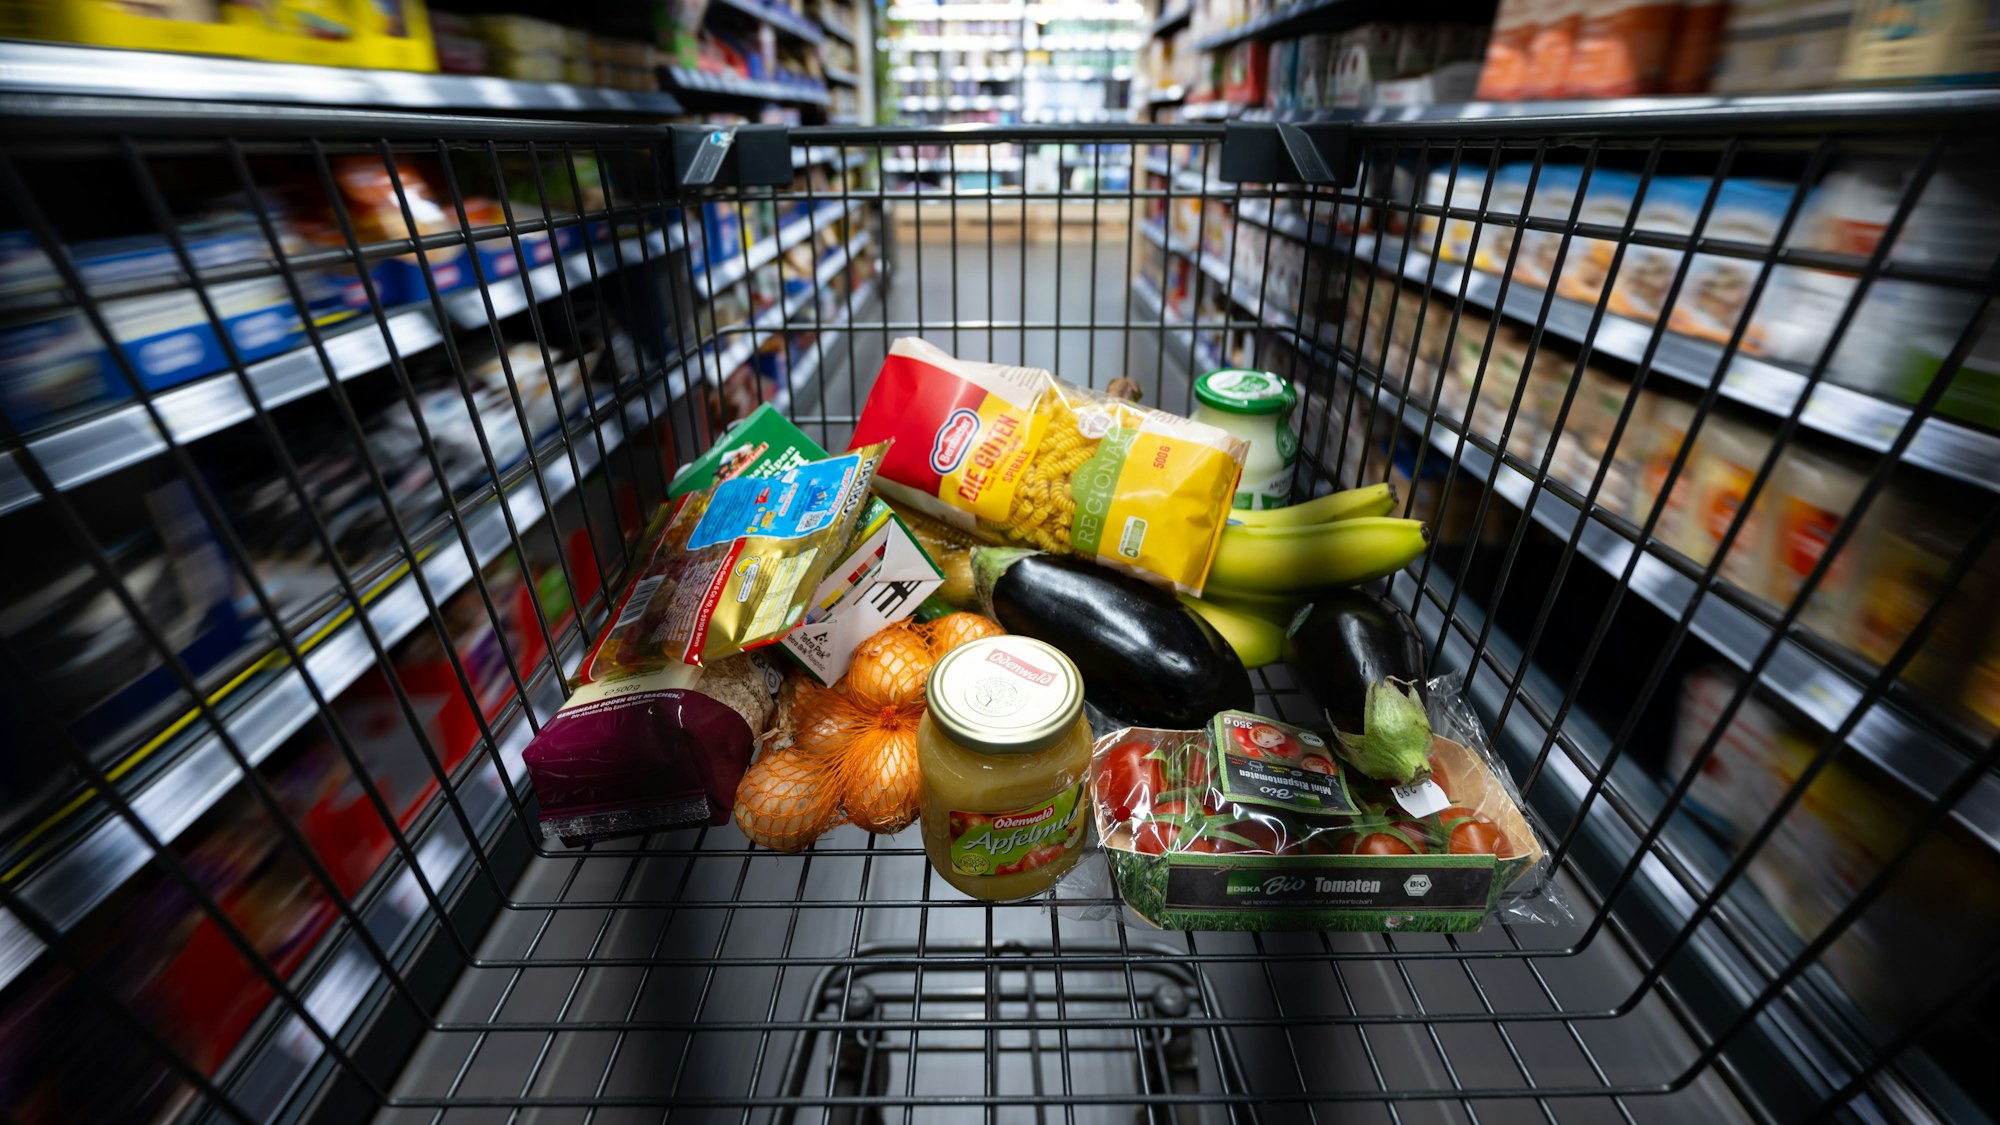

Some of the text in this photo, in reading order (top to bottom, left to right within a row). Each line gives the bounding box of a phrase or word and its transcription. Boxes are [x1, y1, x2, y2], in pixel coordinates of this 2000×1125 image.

[957, 468, 988, 502] DIE
[974, 412, 1019, 471] GUTEN
[1002, 446, 1031, 484] SPIRALE
[1077, 432, 1129, 545] REGIONAL
[715, 569, 726, 586] GmbH
[693, 632, 703, 648] Bonn
[799, 632, 816, 649] Tetra
[786, 634, 799, 647] Tetra
[807, 653, 826, 671] Aseptic
[989, 652, 1053, 685] Odenwald
[556, 703, 600, 719] GEMEINSAM
[600, 697, 627, 708] BODEN
[627, 694, 643, 703] GUT
[1233, 720, 1253, 729] 350
[1239, 769, 1309, 790] Rispentomaten
[1311, 783, 1332, 796] Mini
[1260, 786, 1293, 799] Bio
[994, 807, 1053, 829] Odenwald
[963, 806, 1078, 855] Apfelmus
[1227, 875, 1381, 896] EDEKA Bio Tomaten
